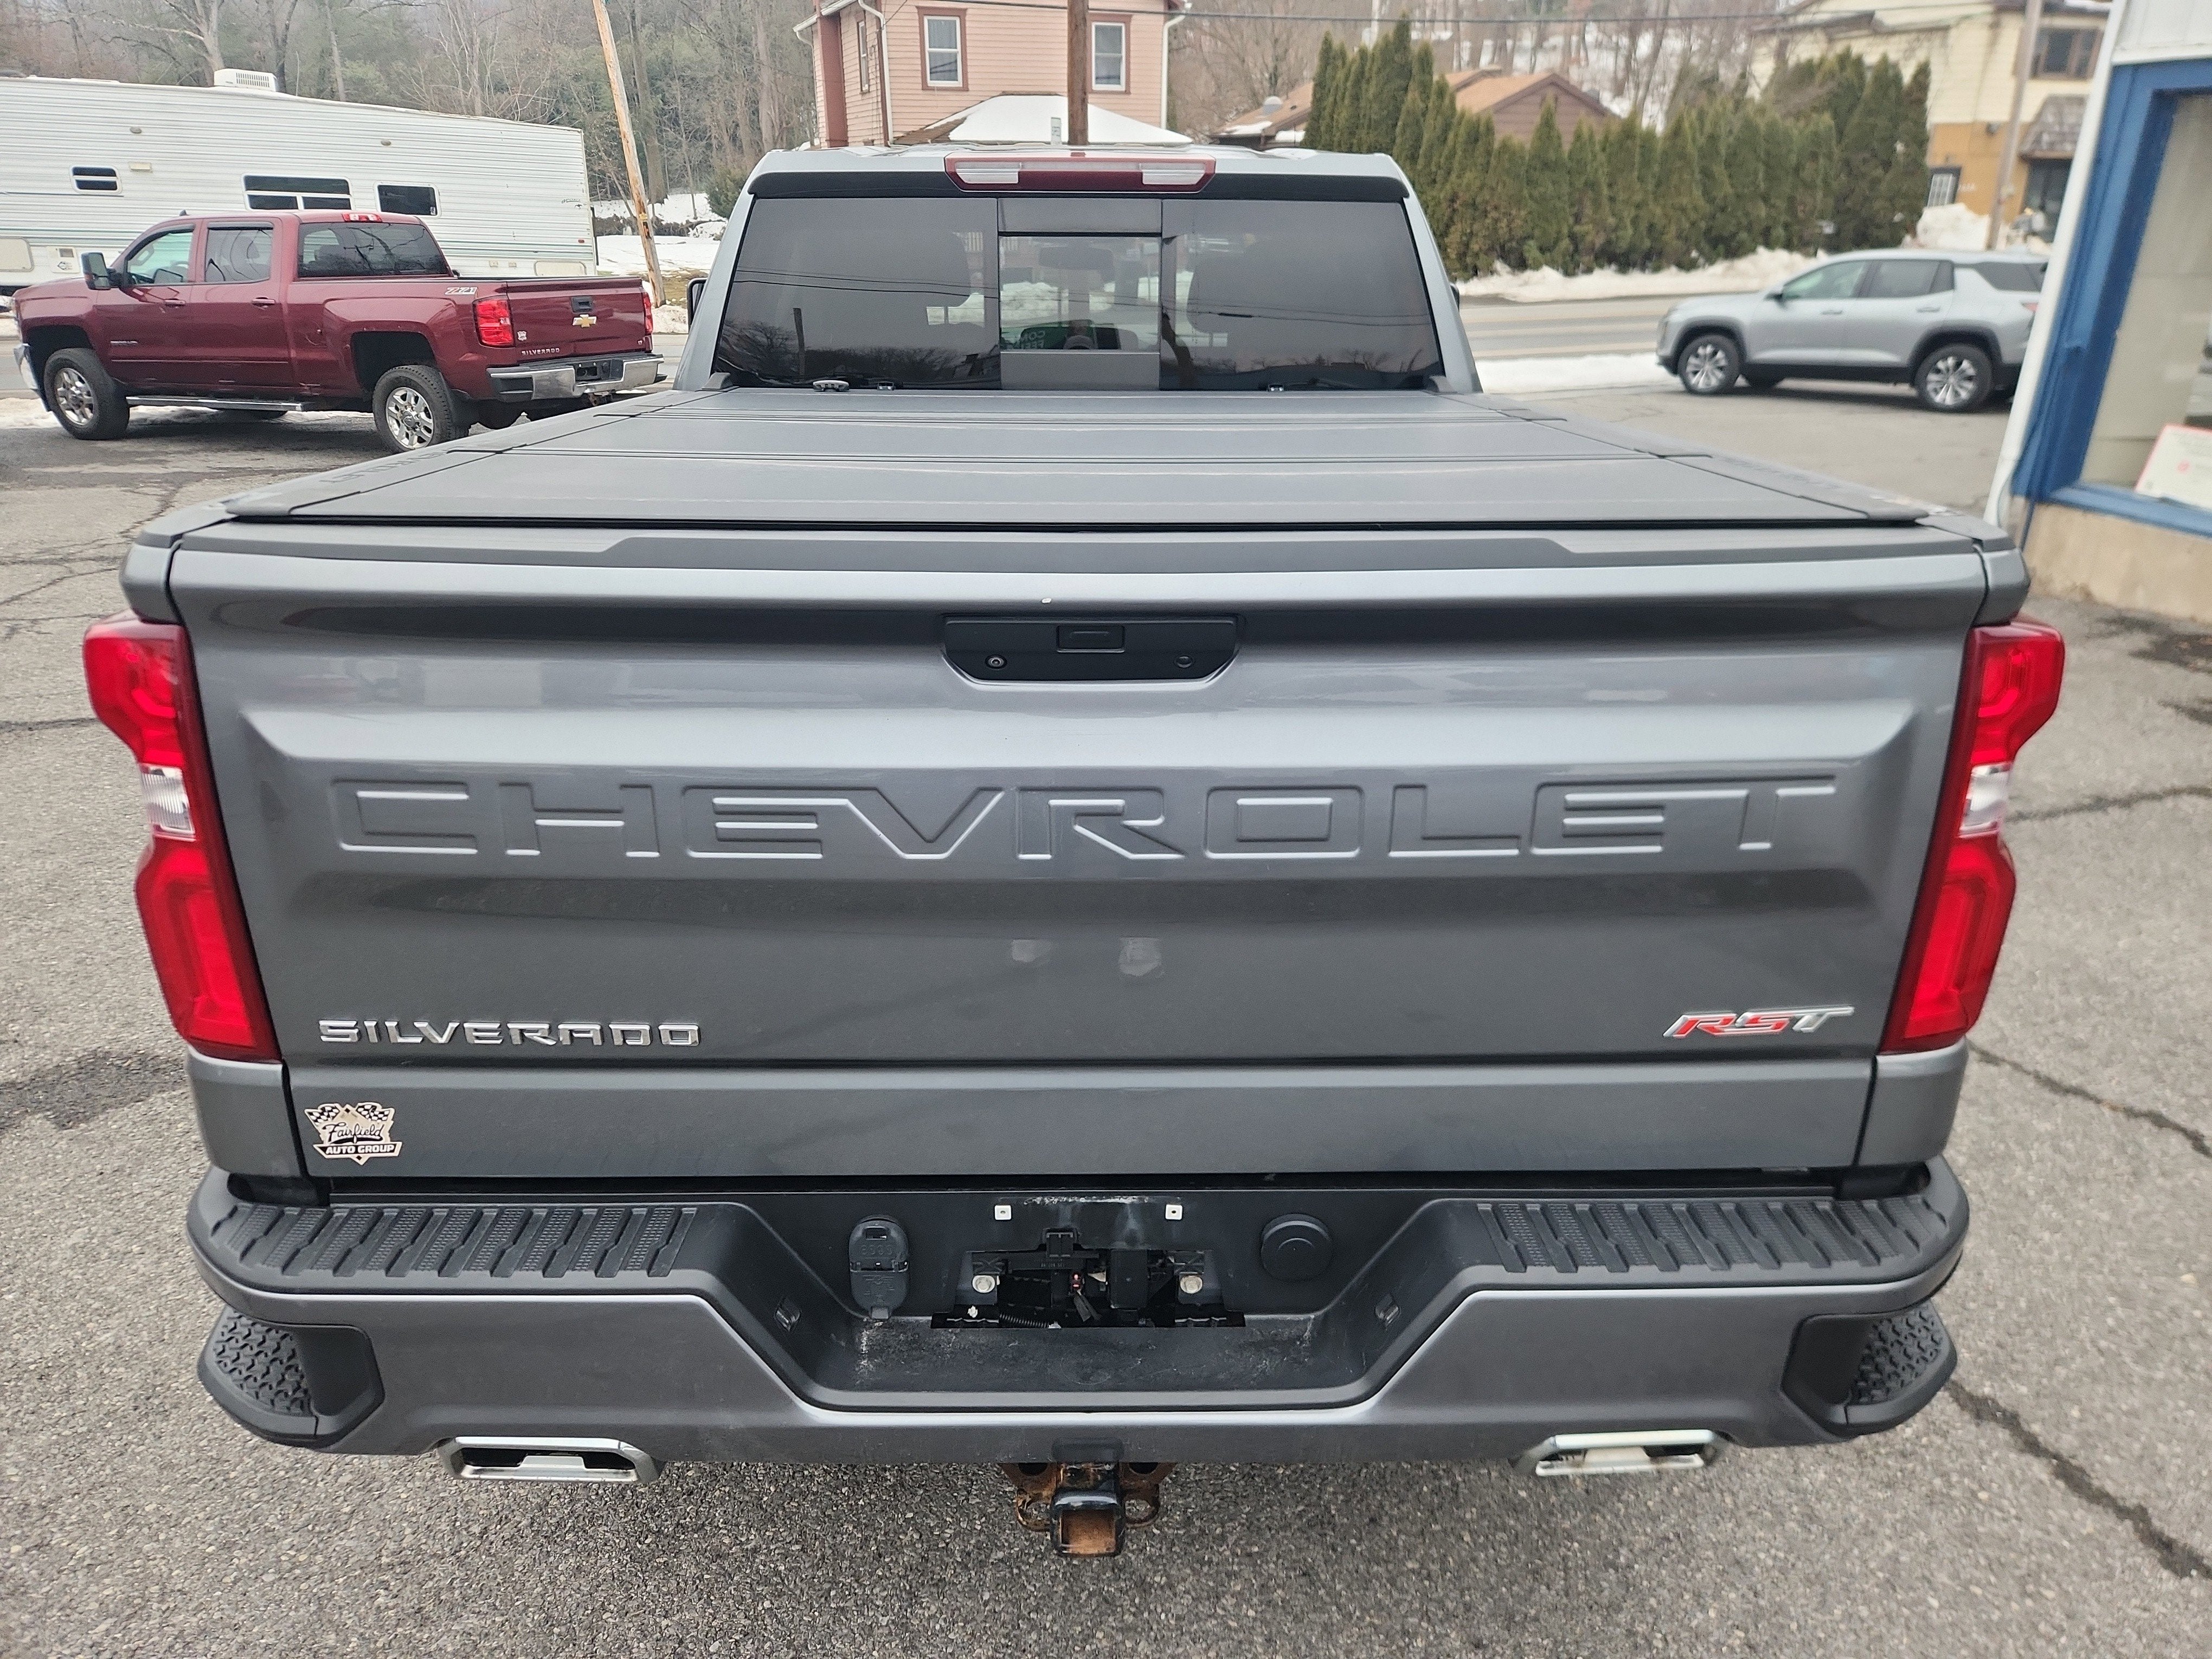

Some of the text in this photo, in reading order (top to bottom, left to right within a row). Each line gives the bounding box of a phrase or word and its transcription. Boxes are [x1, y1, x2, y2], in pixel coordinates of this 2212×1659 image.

[521, 348, 560, 356] SILVERADO
[330, 774, 1836, 860] CHEVROLET
[318, 1020, 702, 1046] SILVERADO
[1662, 1005, 1855, 1039] RST
[322, 1122, 384, 1143] Fairfield
[326, 1144, 395, 1154] AUTO GROUP
